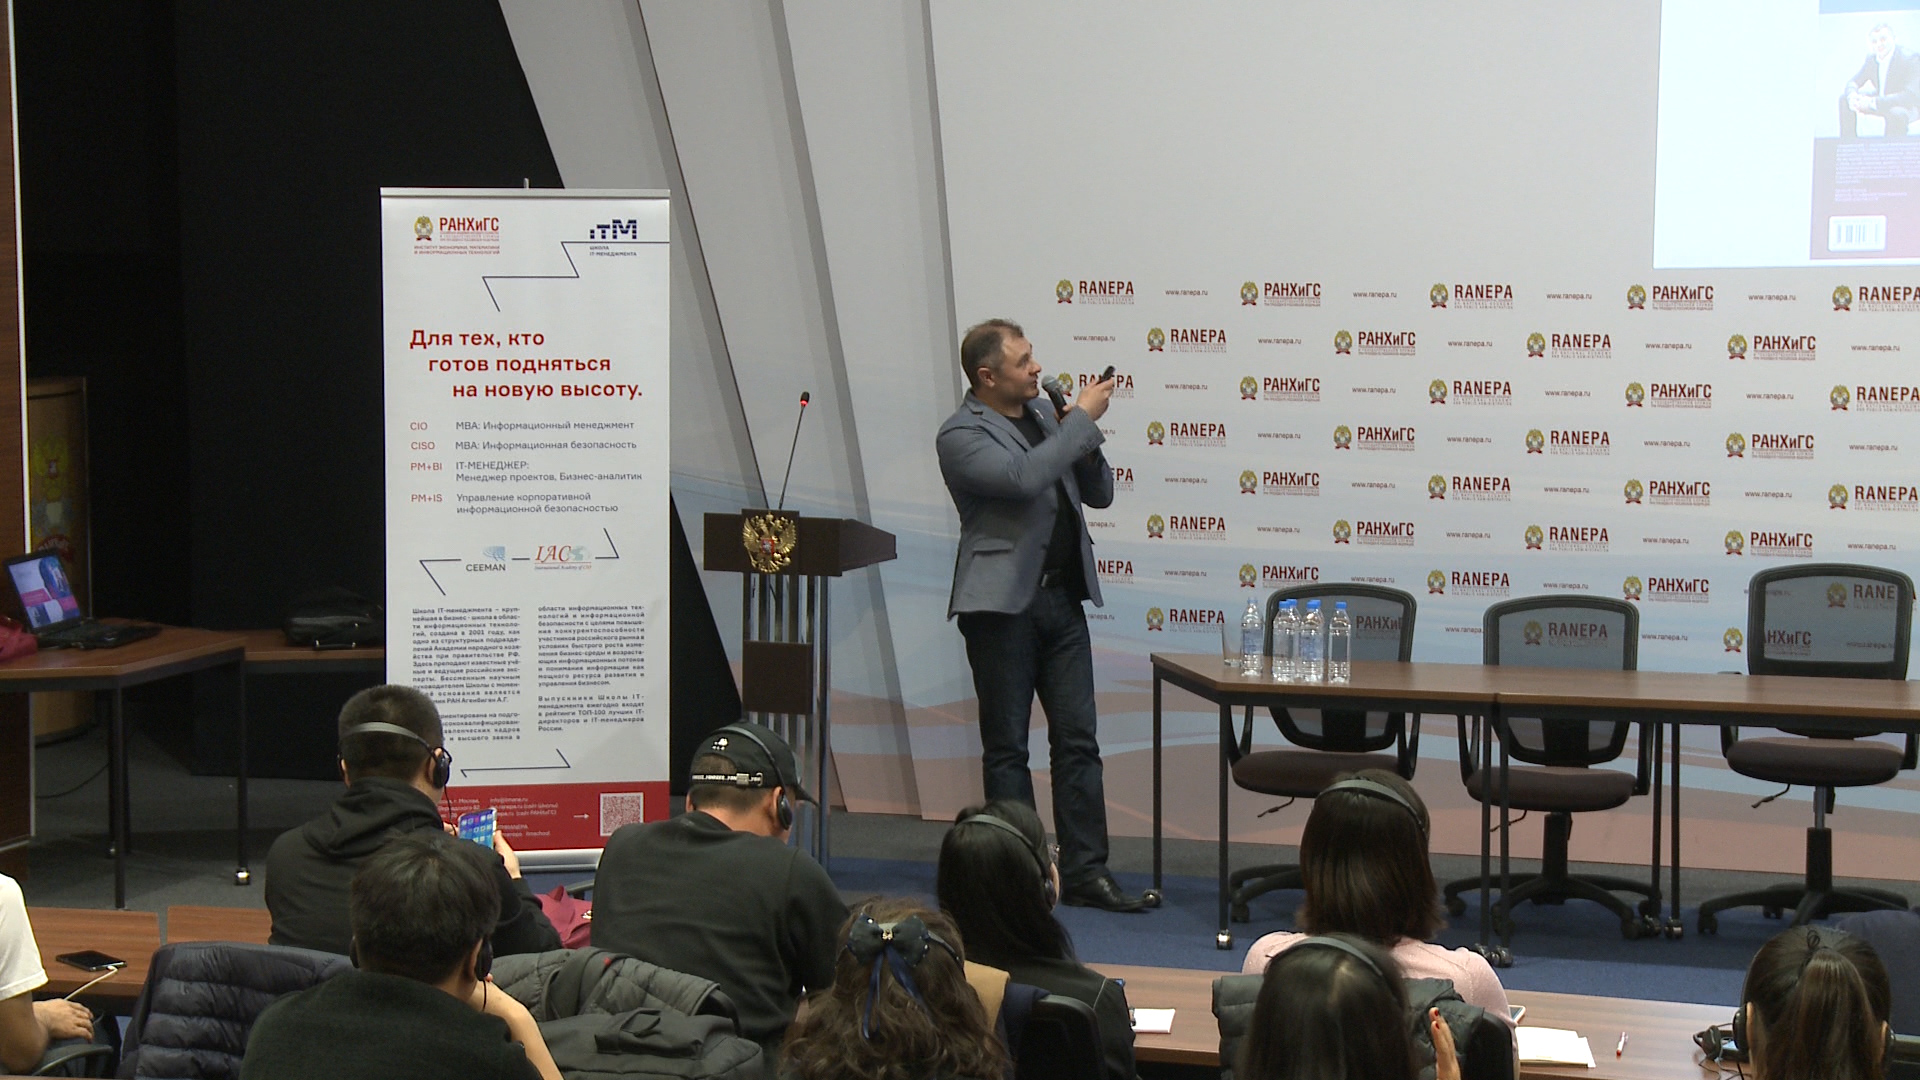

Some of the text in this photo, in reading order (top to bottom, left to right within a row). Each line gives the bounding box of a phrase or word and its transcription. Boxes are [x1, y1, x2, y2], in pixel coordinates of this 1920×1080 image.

[440, 217, 499, 233] РАНХиГС
[1079, 281, 1134, 294] RANEPA
[1264, 283, 1321, 296] РАНХиГС
[1454, 285, 1513, 298] RANEPA
[1164, 289, 1208, 298] www.ranepa.ru
[1353, 291, 1398, 300] www.ranepa.ru
[1547, 293, 1593, 302] www.ranepa.ru
[1652, 286, 1714, 300] РАНХиГС
[1748, 294, 1797, 303] www.ranepa.ru
[410, 330, 544, 349] Для тех, кто
[1073, 335, 1116, 344] www.ranepa.ru
[1170, 329, 1227, 343] RANEPA
[1358, 332, 1416, 345] РАНХиГС
[1551, 334, 1611, 348] RANEPA
[1257, 338, 1301, 347] www.ranepa.ru
[1448, 340, 1493, 349] www.ranepa.ru
[1645, 343, 1693, 352] www.ranepa.ru
[1753, 336, 1816, 350] РАНХиГС
[1851, 345, 1901, 354] www.ranepa.ru
[429, 359, 610, 374] готов подняться
[1164, 383, 1207, 392] www.ranepa.ru
[1263, 378, 1320, 391] РАНХиГС
[1453, 381, 1512, 395] RANEPA
[453, 384, 642, 400] на новую высоту.
[1351, 387, 1396, 396] www.ranepa.ru
[1545, 390, 1591, 399] www.ranepa.ru
[1650, 384, 1712, 398] РАНХиГС
[1856, 387, 1920, 401] RANEPA
[1746, 393, 1795, 402] www.ranepa.ru
[410, 422, 428, 431] CIO
[456, 422, 480, 430] MBA:
[483, 421, 571, 431] Информационный
[1170, 423, 1226, 437] RANEPA
[1257, 432, 1301, 442] www.ranepa.ru
[1357, 427, 1415, 441] РАНХиГС
[1550, 431, 1610, 445] RANEPA
[411, 441, 435, 450] CISO
[1447, 436, 1492, 445] www.ranepa.ru
[1644, 440, 1691, 449] www.ranepa.ru
[1751, 434, 1815, 449] РАНХиГС
[455, 441, 637, 451] MBA: Информационная безопасность
[1849, 444, 1899, 453] www.ranepa.ru
[411, 462, 442, 471] PM+BI
[456, 461, 529, 471] IT-МЕНЕДЖЕР:
[456, 472, 642, 483] Менеджер проектов, Бизнес-аналитик
[1164, 477, 1207, 486] www.ranepa.ru
[1263, 472, 1320, 486] РАНХиГС
[1351, 482, 1395, 491] www.ranepa.ru
[1452, 477, 1511, 491] RANEPA
[1649, 481, 1711, 495] РАНХиГС
[1544, 486, 1590, 496] www.ranepa.ru
[1745, 491, 1793, 500] www.ranepa.ru
[1854, 486, 1919, 500] RANEPA
[411, 494, 443, 502] PM+IS
[457, 492, 591, 503] Управление корпоративной
[457, 504, 618, 515] информационной безопасностью
[1170, 516, 1226, 530] RANEPA
[1256, 526, 1300, 535] www.ranepa.ru
[1356, 522, 1415, 536] РАНХиГС
[1549, 527, 1609, 541] RANEPA
[1446, 531, 1491, 540] www.ranepa.ru
[1750, 532, 1813, 547] РАНХиГС
[1643, 537, 1690, 546] www.ranepa.ru
[1848, 543, 1897, 552] www.ranepa.ru
[466, 564, 506, 572] CEEMAN
[1097, 560, 1133, 574] NEPA
[1163, 570, 1206, 579] www.ranepa.ru
[1262, 566, 1319, 580] РАНХиГС
[1351, 576, 1395, 585] www.ranepa.ru
[1451, 572, 1510, 586] RANEPA
[1543, 582, 1589, 591] www.ranepa.ru
[1648, 578, 1709, 592] РАНХиГС
[1169, 609, 1225, 623] RANEPA
[1548, 622, 1609, 638] RANEPA
[1641, 633, 1688, 641] www.ranepa.ru
